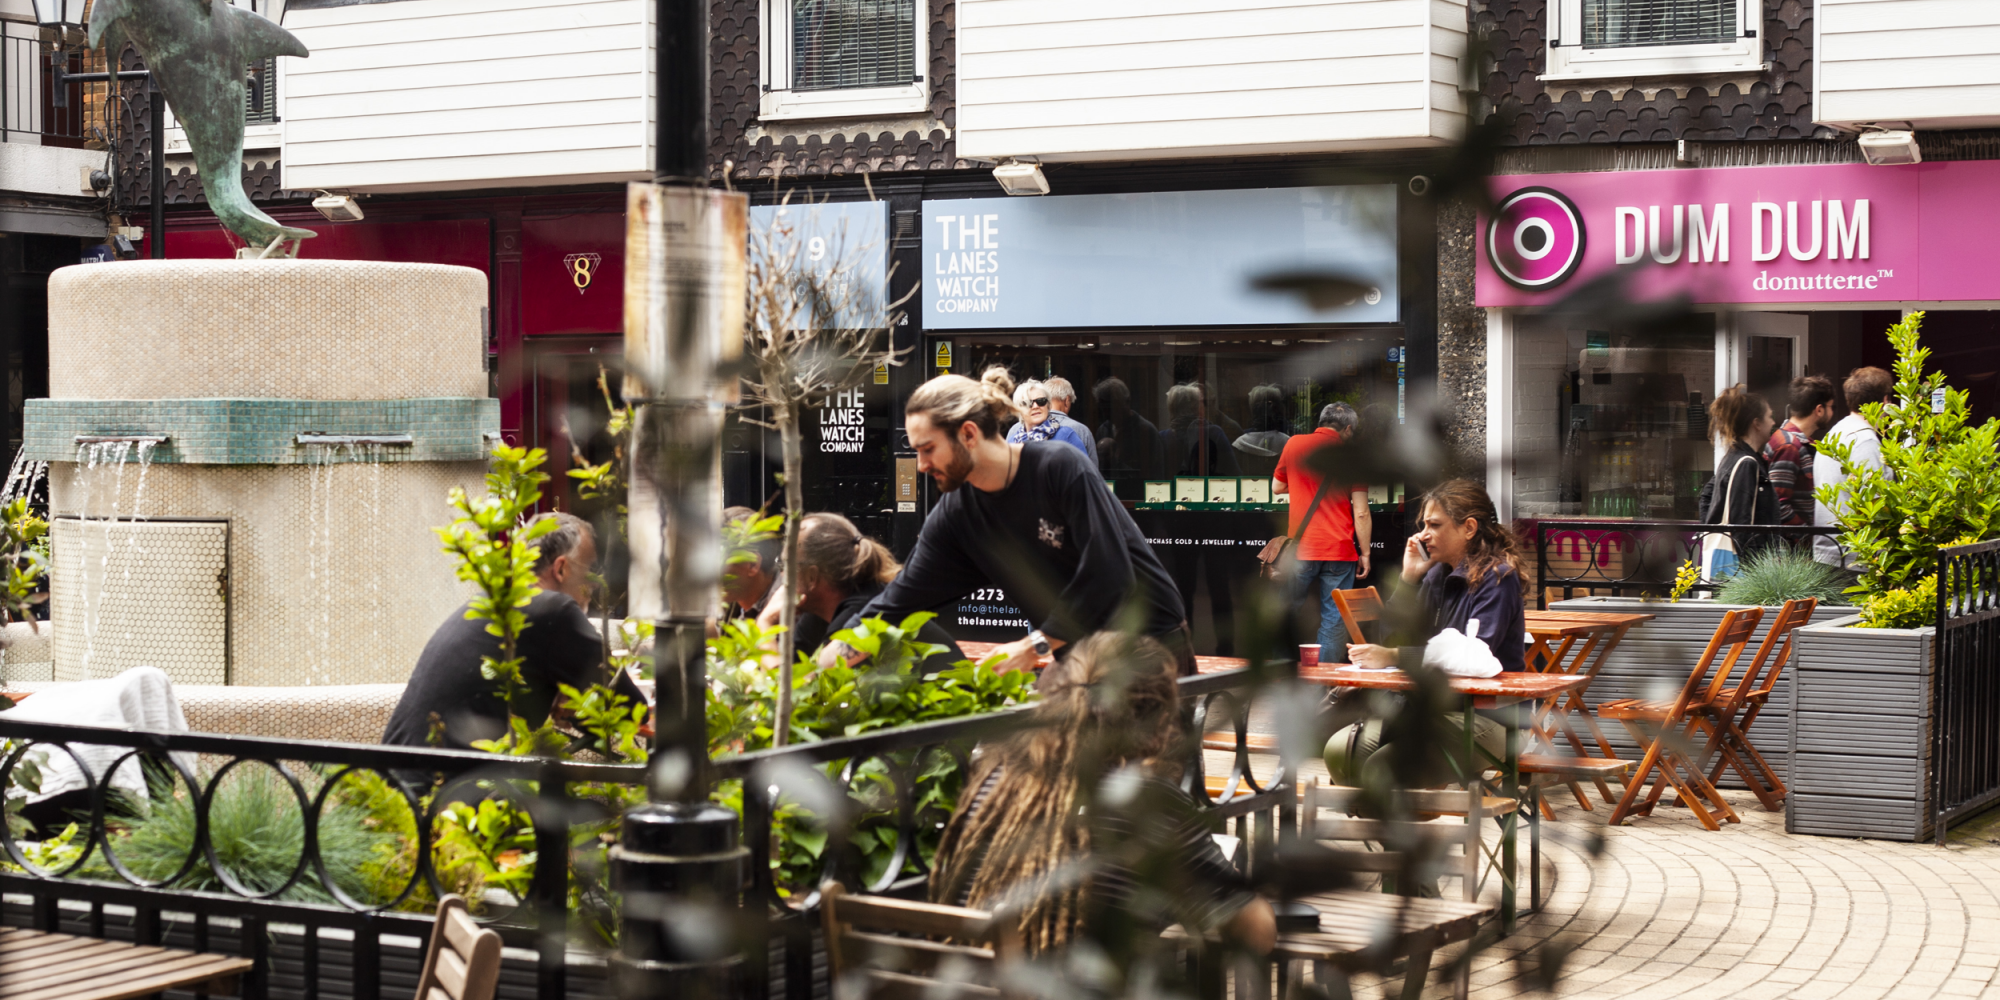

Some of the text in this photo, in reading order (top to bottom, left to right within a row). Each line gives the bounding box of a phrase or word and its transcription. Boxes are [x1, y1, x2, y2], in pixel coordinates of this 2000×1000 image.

[935, 214, 999, 251] THE
[1615, 199, 1870, 265] DUM DUM
[808, 236, 826, 261] 9
[573, 257, 592, 289] 8
[935, 251, 999, 275] LANES
[935, 276, 999, 298] WATCH
[935, 297, 999, 314] COMPANY
[821, 383, 865, 408] THE
[820, 408, 865, 426] LANES
[820, 426, 865, 442] WATCH
[820, 441, 865, 453] COMPANY
[1144, 537, 1173, 545] URCHASE
[962, 588, 1004, 601] 1273
